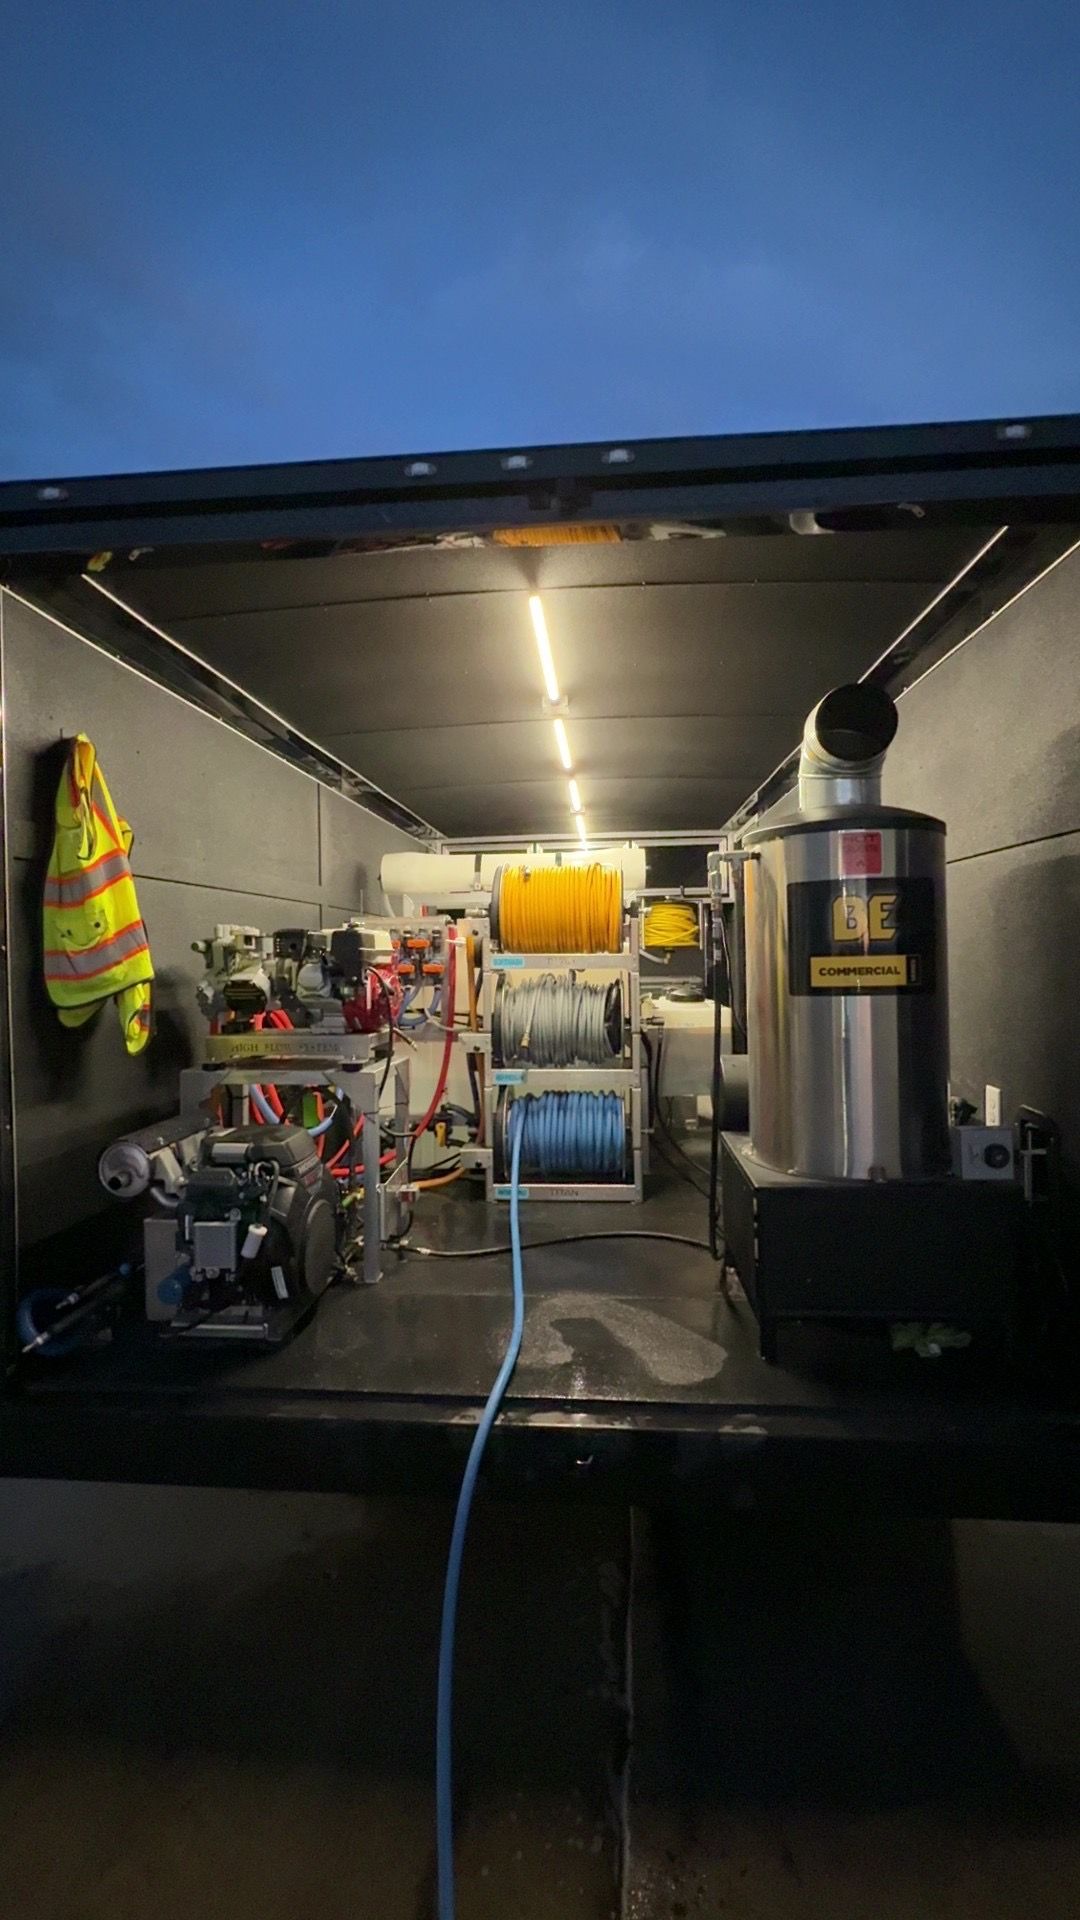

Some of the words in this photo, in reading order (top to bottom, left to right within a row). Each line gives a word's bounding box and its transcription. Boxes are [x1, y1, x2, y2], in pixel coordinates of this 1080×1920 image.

[832, 894, 897, 942] BE
[819, 966, 901, 976] COMMERCIAL
[231, 1043, 258, 1052] HIGH
